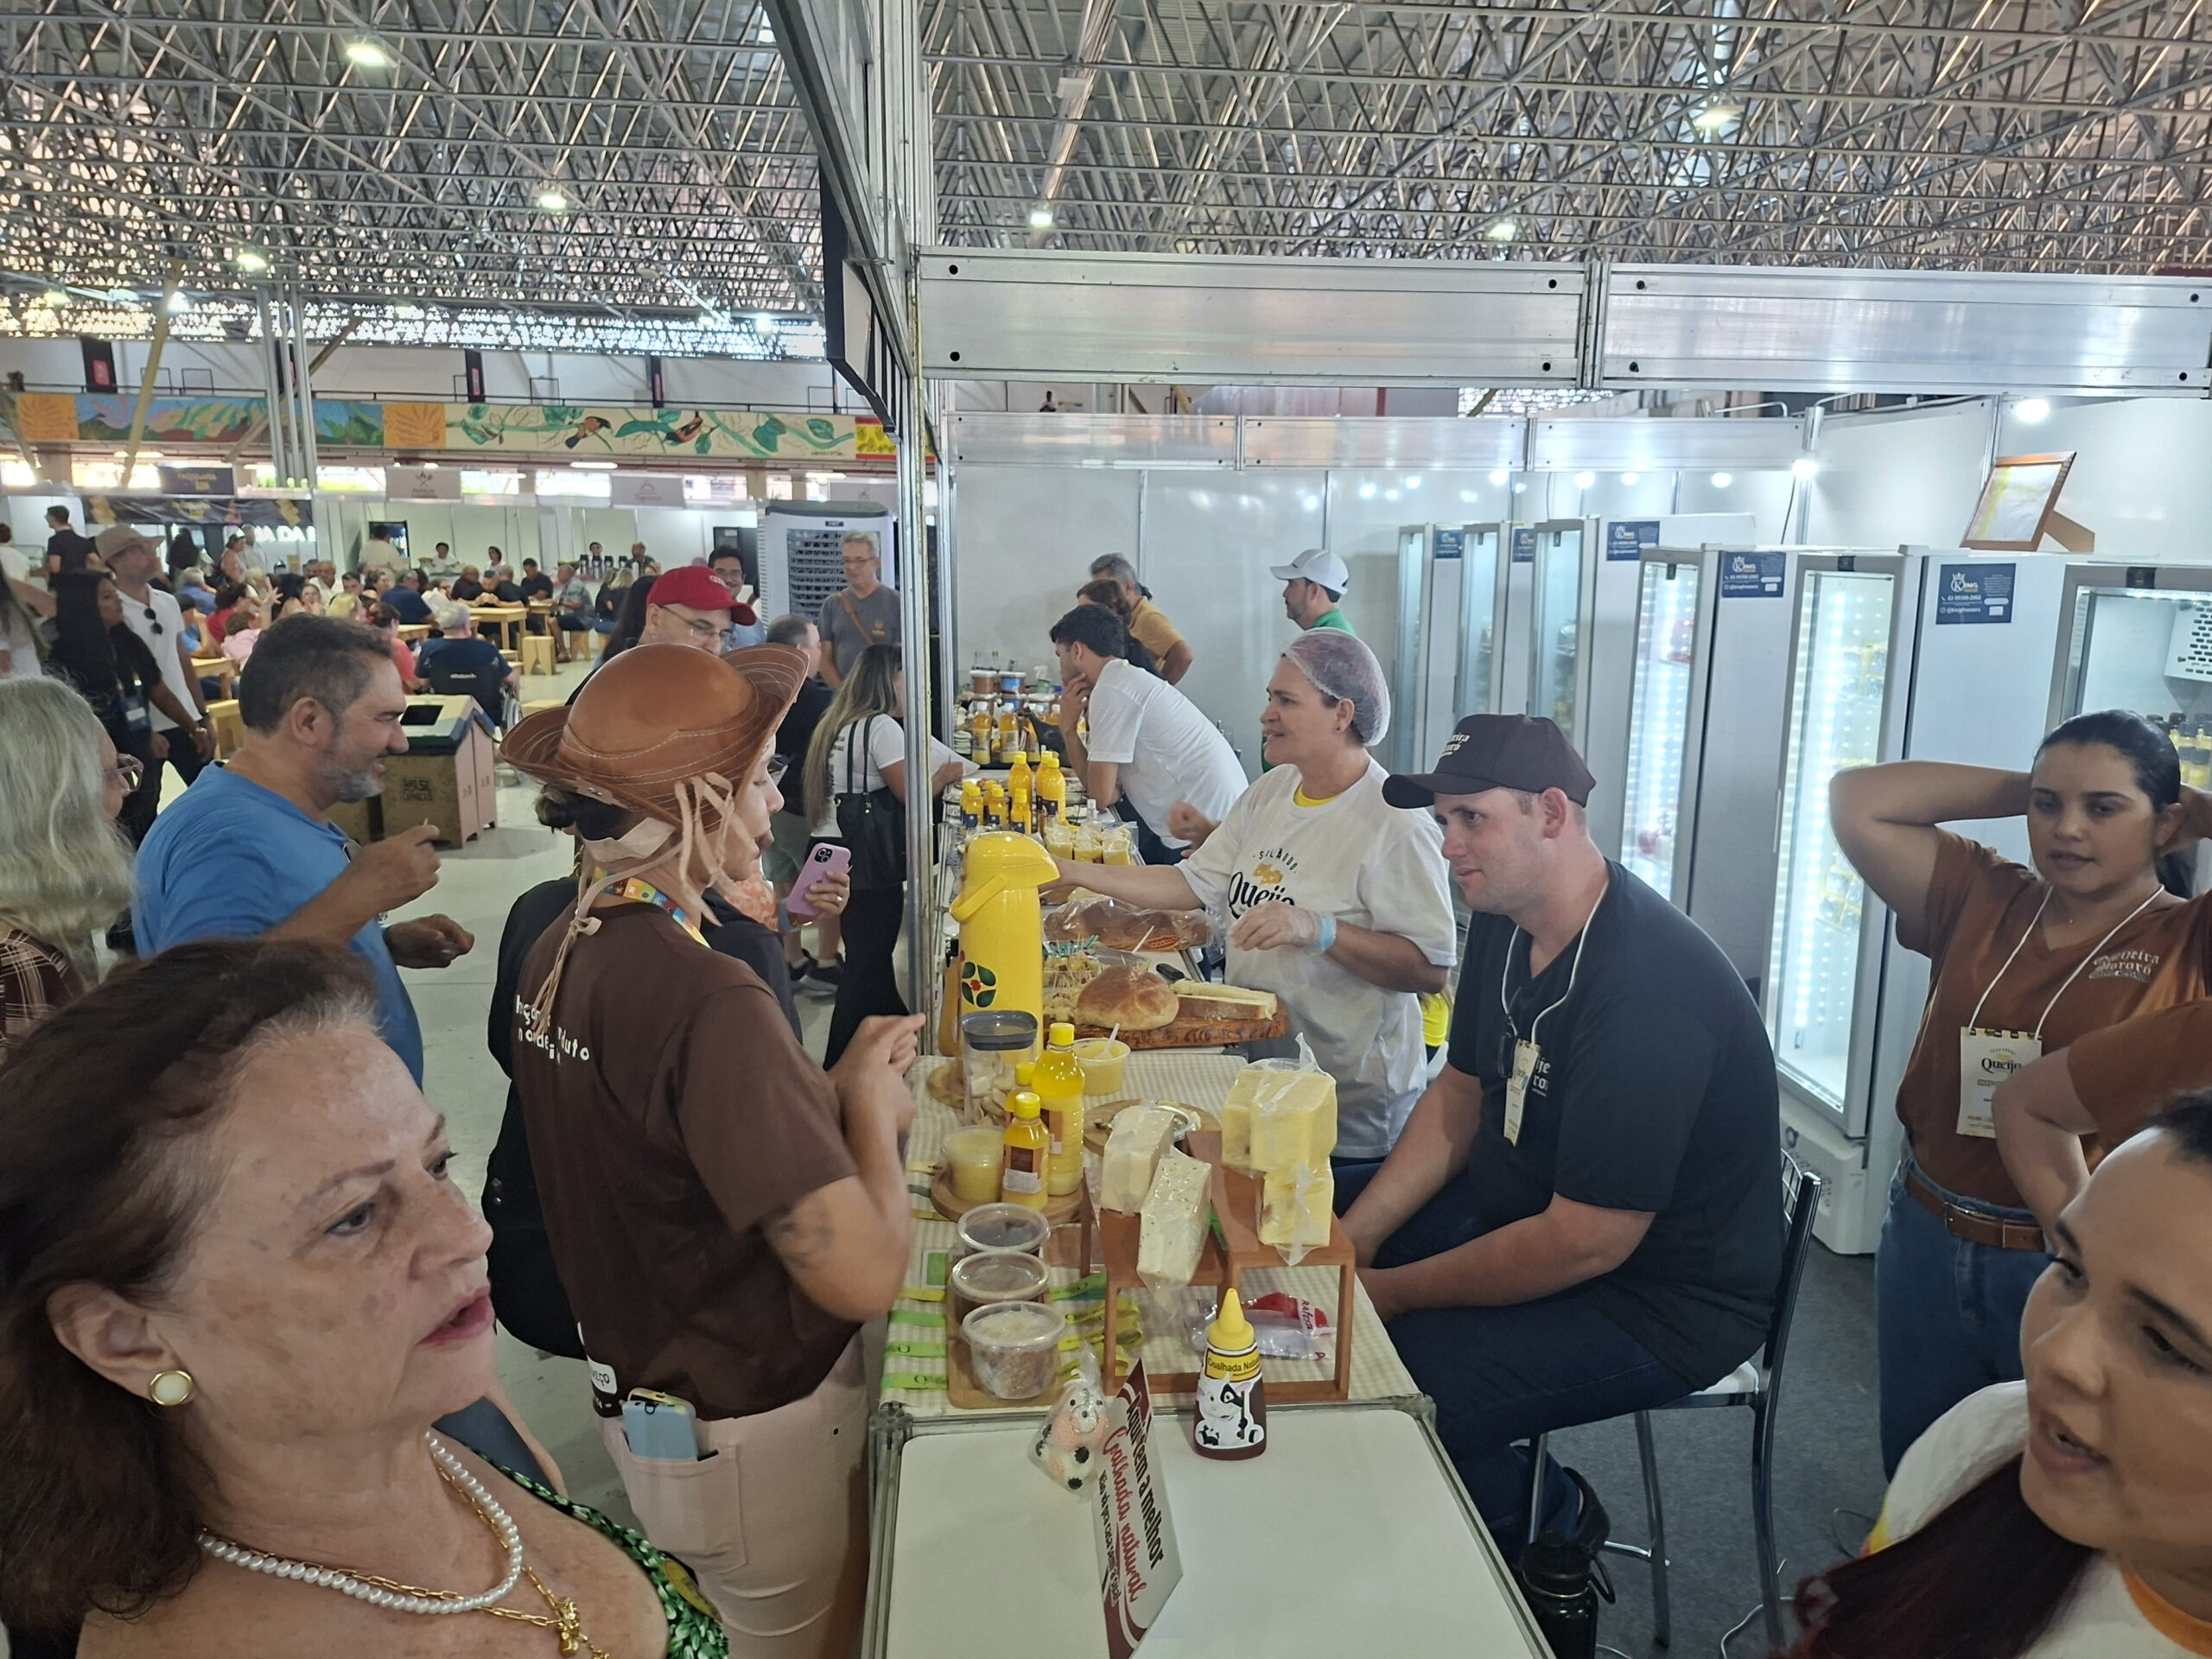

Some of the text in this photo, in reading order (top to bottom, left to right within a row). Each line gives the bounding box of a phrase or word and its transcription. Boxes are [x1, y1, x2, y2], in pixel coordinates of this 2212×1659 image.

[1208, 1357, 1242, 1372] Coalhada
[1103, 1425, 1147, 1604] Coalhada natural
[1126, 1392, 1165, 1570] Aqui tem a melhor
